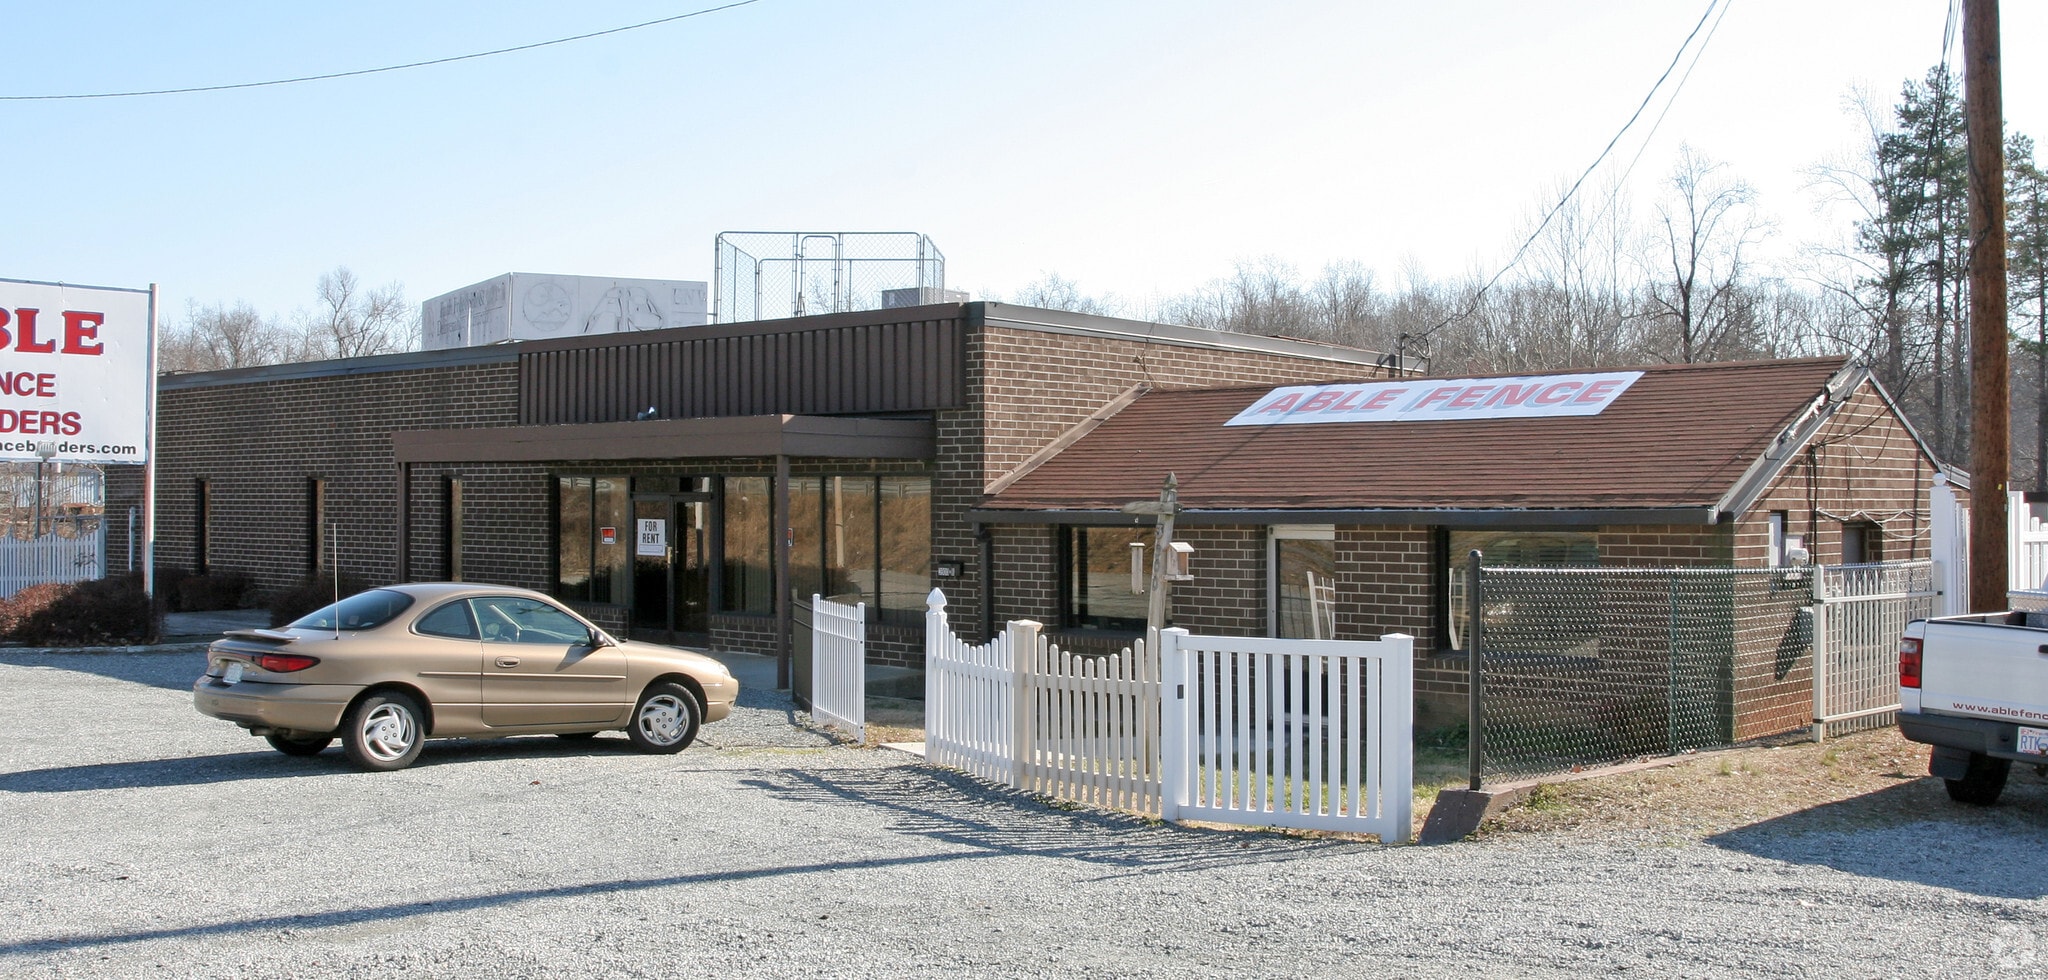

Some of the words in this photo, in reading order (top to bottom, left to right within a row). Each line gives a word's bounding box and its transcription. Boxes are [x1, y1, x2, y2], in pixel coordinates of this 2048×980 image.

[1248, 387, 1409, 417] ABLE
[1403, 379, 1626, 411] FENCE
[0, 408, 82, 436] DERS
[644, 521, 658, 532] FOR
[642, 533, 660, 543] RENT
